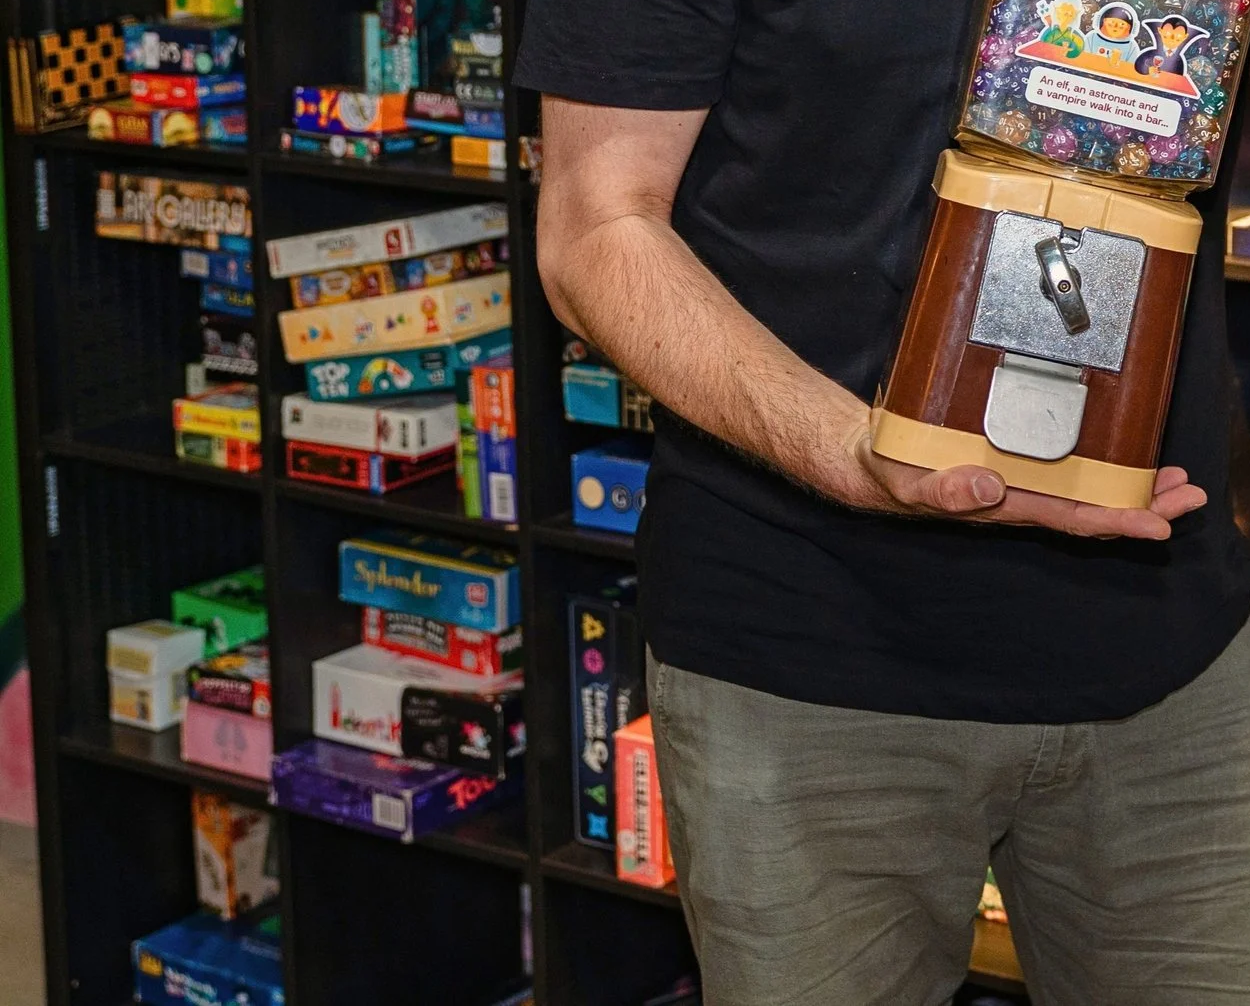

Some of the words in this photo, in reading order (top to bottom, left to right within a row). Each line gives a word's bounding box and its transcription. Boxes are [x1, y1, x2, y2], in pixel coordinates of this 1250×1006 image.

[1040, 75, 1053, 87] An
[1056, 79, 1070, 92] elf,
[1074, 85, 1086, 95] an
[1089, 89, 1137, 107] astronaut
[1139, 101, 1159, 113] and
[1046, 90, 1087, 107] vampire
[1090, 101, 1112, 113] walk
[1115, 107, 1134, 119] into
[1145, 114, 1169, 129] bar...
[354, 558, 441, 599] Splendor
